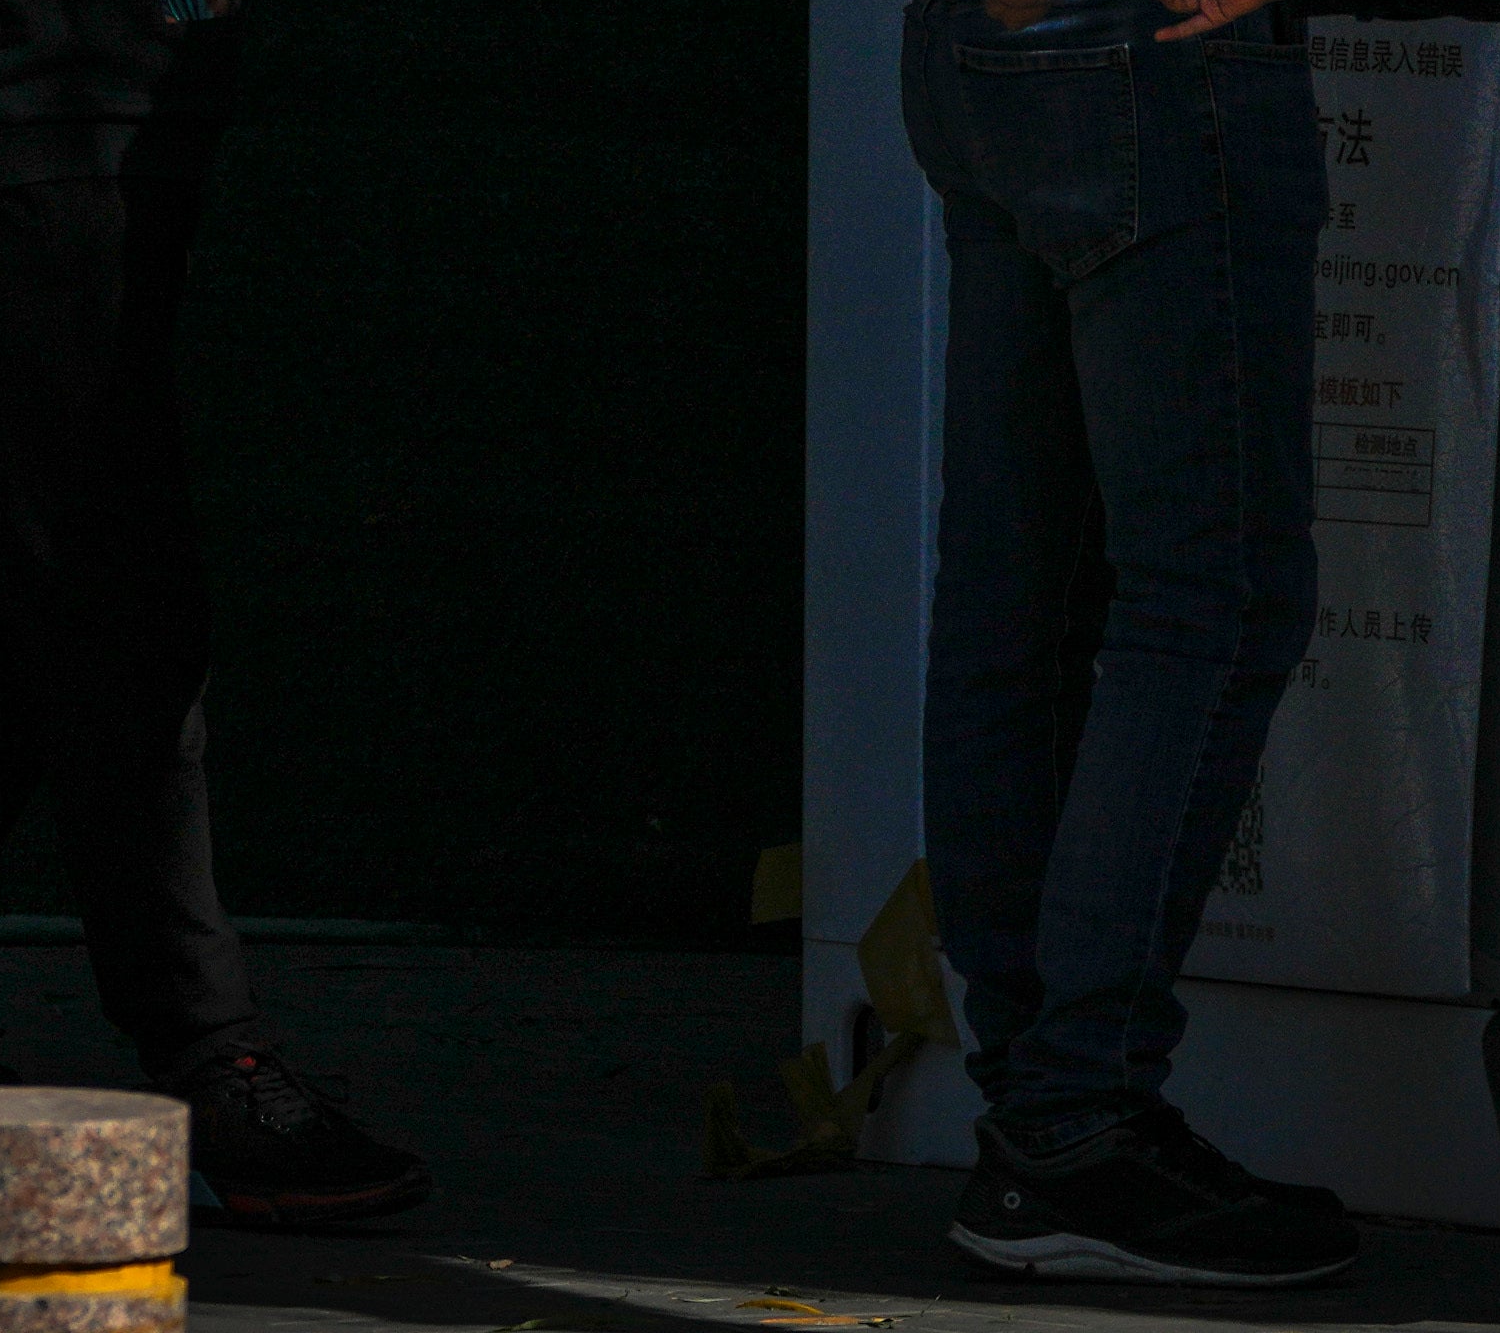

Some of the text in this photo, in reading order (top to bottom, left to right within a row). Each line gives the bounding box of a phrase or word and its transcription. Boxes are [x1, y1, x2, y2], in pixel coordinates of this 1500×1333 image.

[1309, 36, 1463, 77] 是信息录入错误
[1353, 433, 1418, 457] 检测地点
